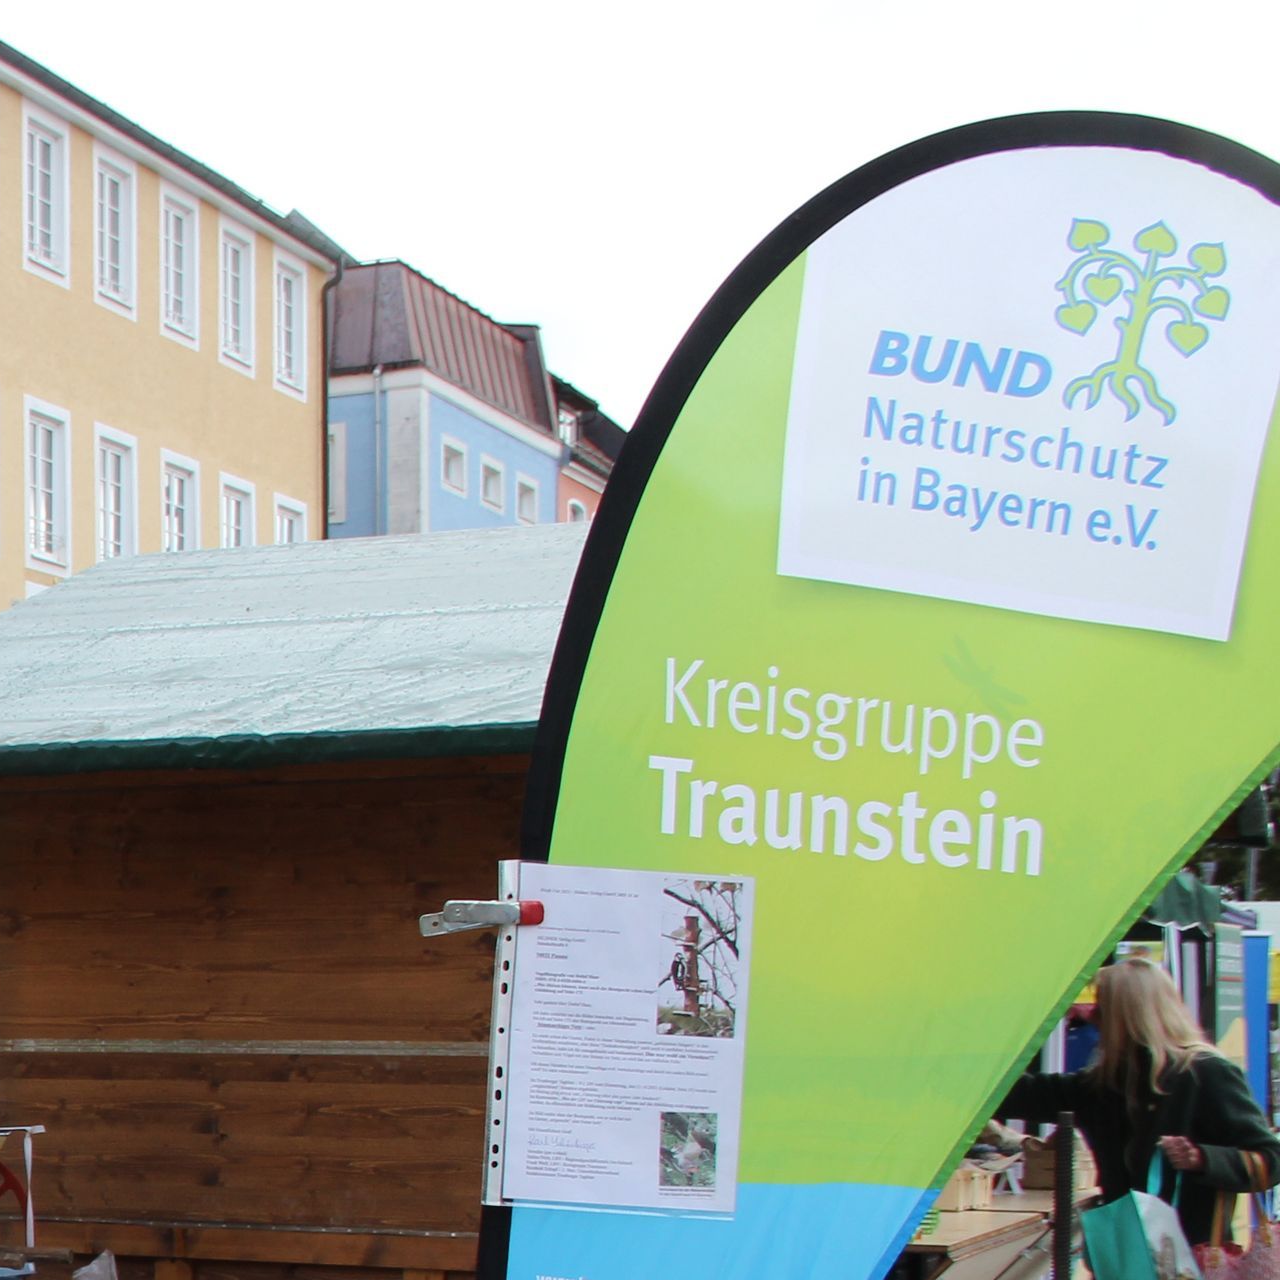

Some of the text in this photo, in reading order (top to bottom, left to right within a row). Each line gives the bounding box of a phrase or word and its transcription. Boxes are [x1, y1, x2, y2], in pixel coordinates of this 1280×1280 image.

[868, 329, 1052, 400] BUND
[863, 396, 1169, 489] Naturschutz
[857, 457, 1159, 551] in Bayern e.V.
[665, 655, 1045, 779] Kreisgruppe
[649, 755, 1044, 876] Traunstein
